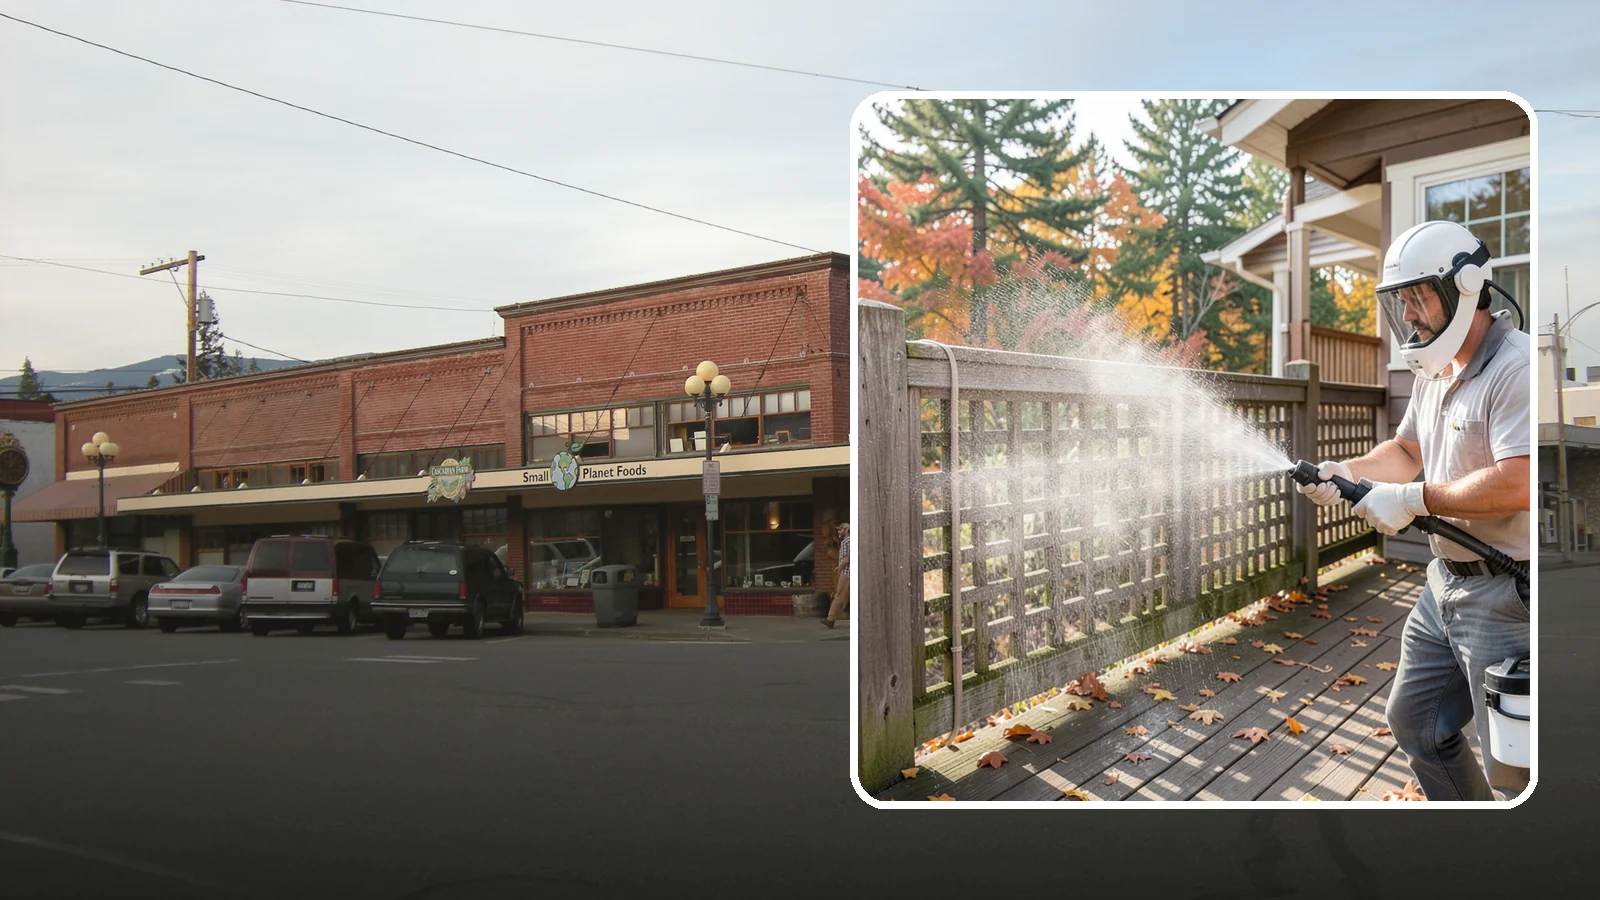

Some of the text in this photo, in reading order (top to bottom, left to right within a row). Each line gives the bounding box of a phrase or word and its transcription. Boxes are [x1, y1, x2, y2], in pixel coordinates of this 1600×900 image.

[523, 464, 647, 483] Small Planet Foods
